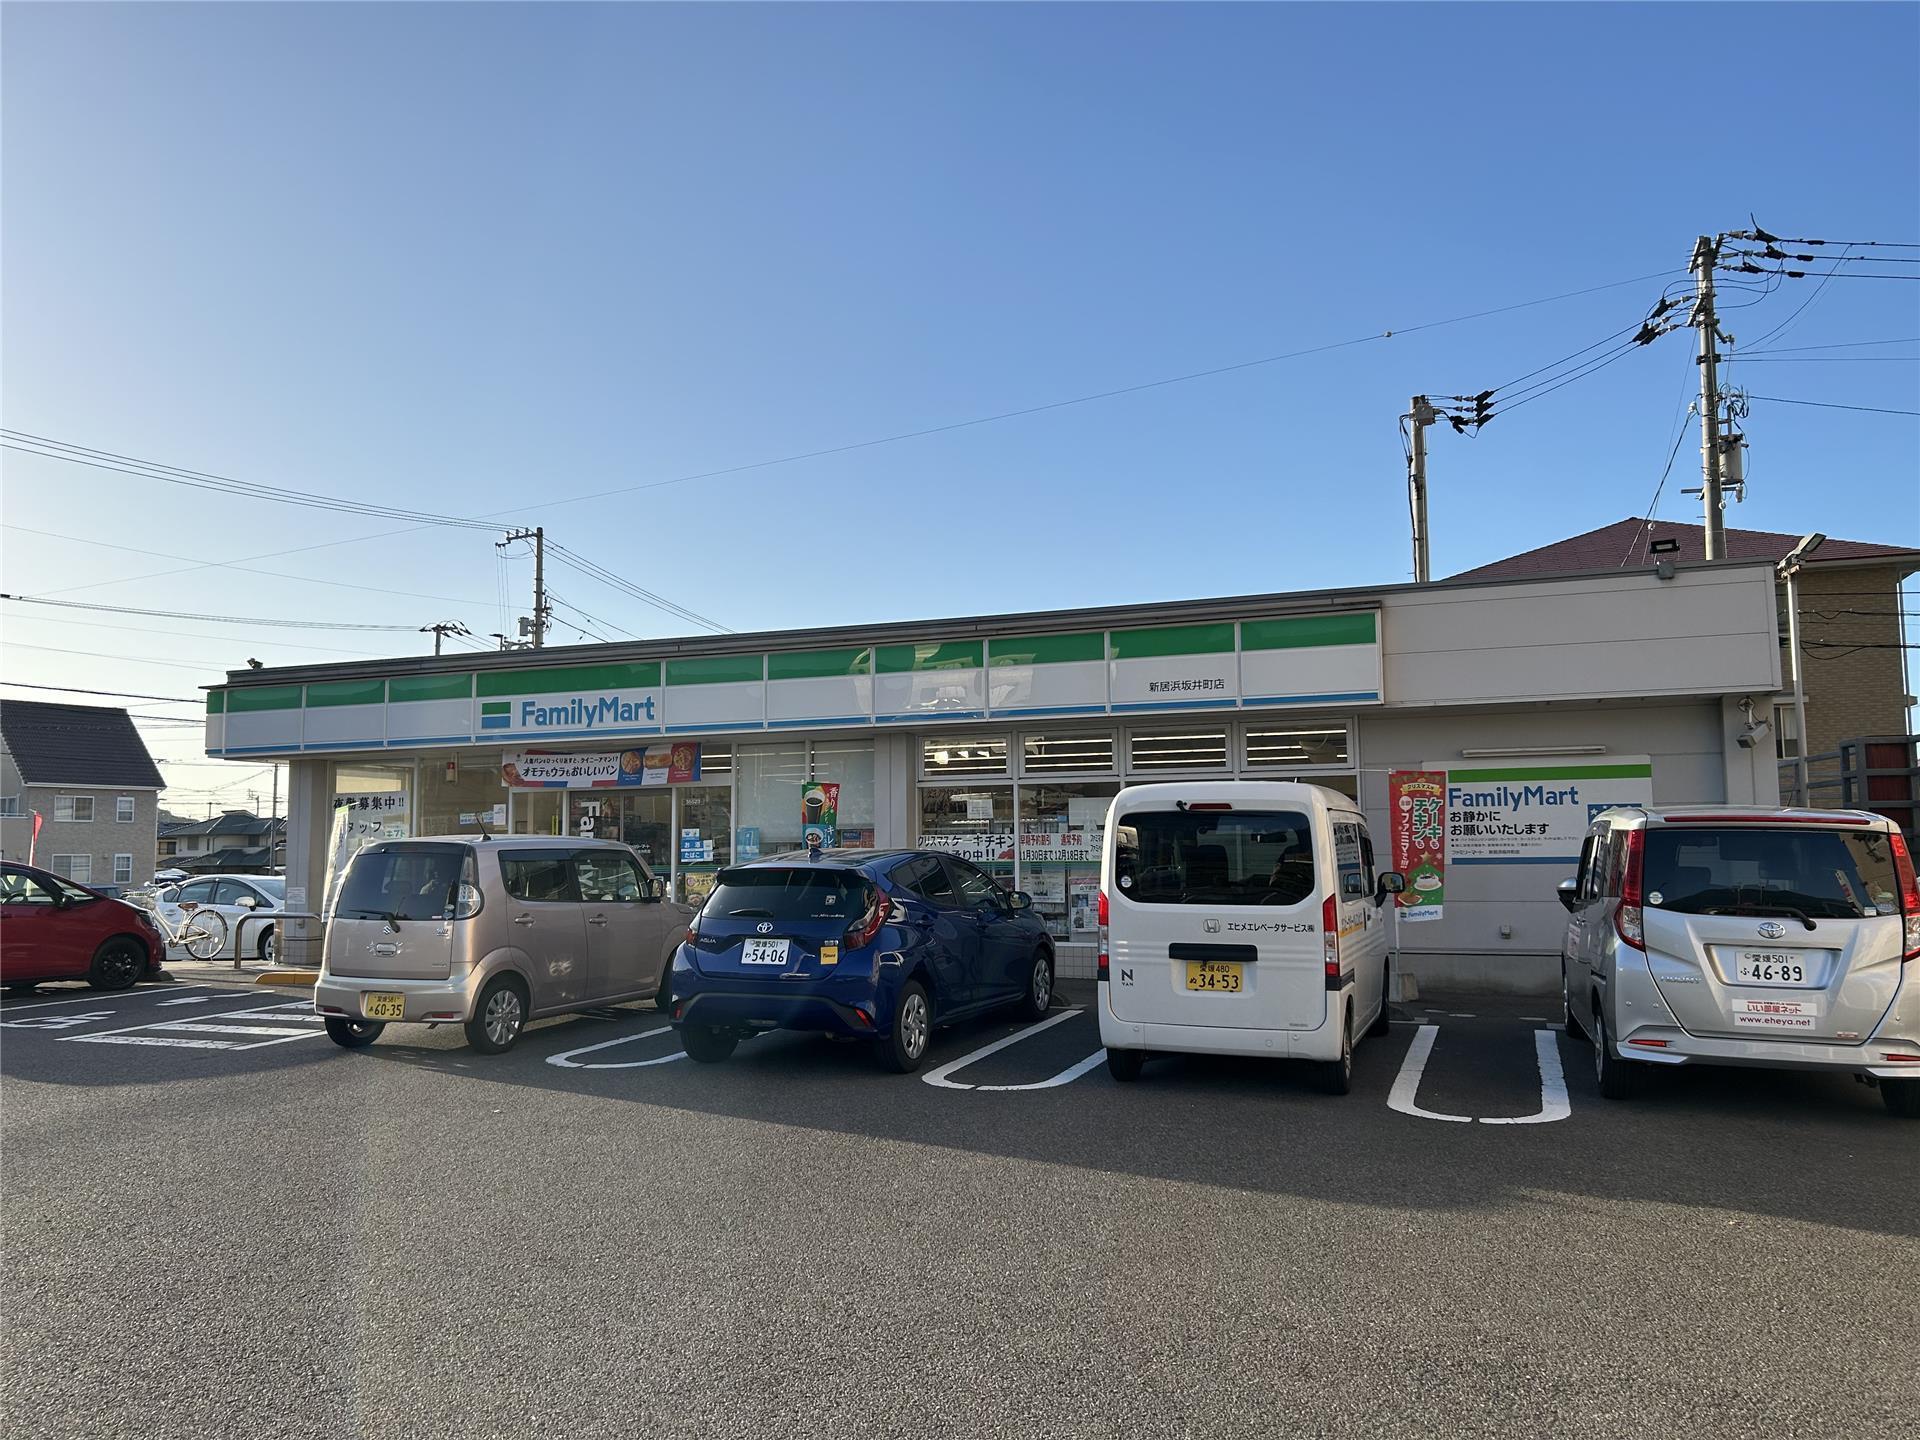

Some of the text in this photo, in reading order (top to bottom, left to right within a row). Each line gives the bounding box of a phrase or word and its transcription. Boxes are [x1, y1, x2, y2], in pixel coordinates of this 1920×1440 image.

[1149, 679, 1224, 692] 新居浜坂井町店
[521, 696, 655, 728] FamilyMart
[522, 766, 617, 778] オモテもウラもおいしいパン
[1448, 785, 1579, 811] FamilyMart
[1450, 810, 1501, 822] お静かに
[348, 821, 382, 834] タッフ
[1412, 798, 1428, 849] チキンも
[1427, 797, 1443, 849] ケーキも
[1451, 823, 1549, 836] お願いいたします
[752, 949, 785, 962] 54-06
[1121, 969, 1133, 981] N
[1752, 964, 1803, 982] 46-89
[1199, 974, 1239, 989] 34-53
[374, 1003, 402, 1016] 60-35
[1747, 1004, 1802, 1012] いい部屋ネット
[1740, 1016, 1811, 1026] www.eheya.net
